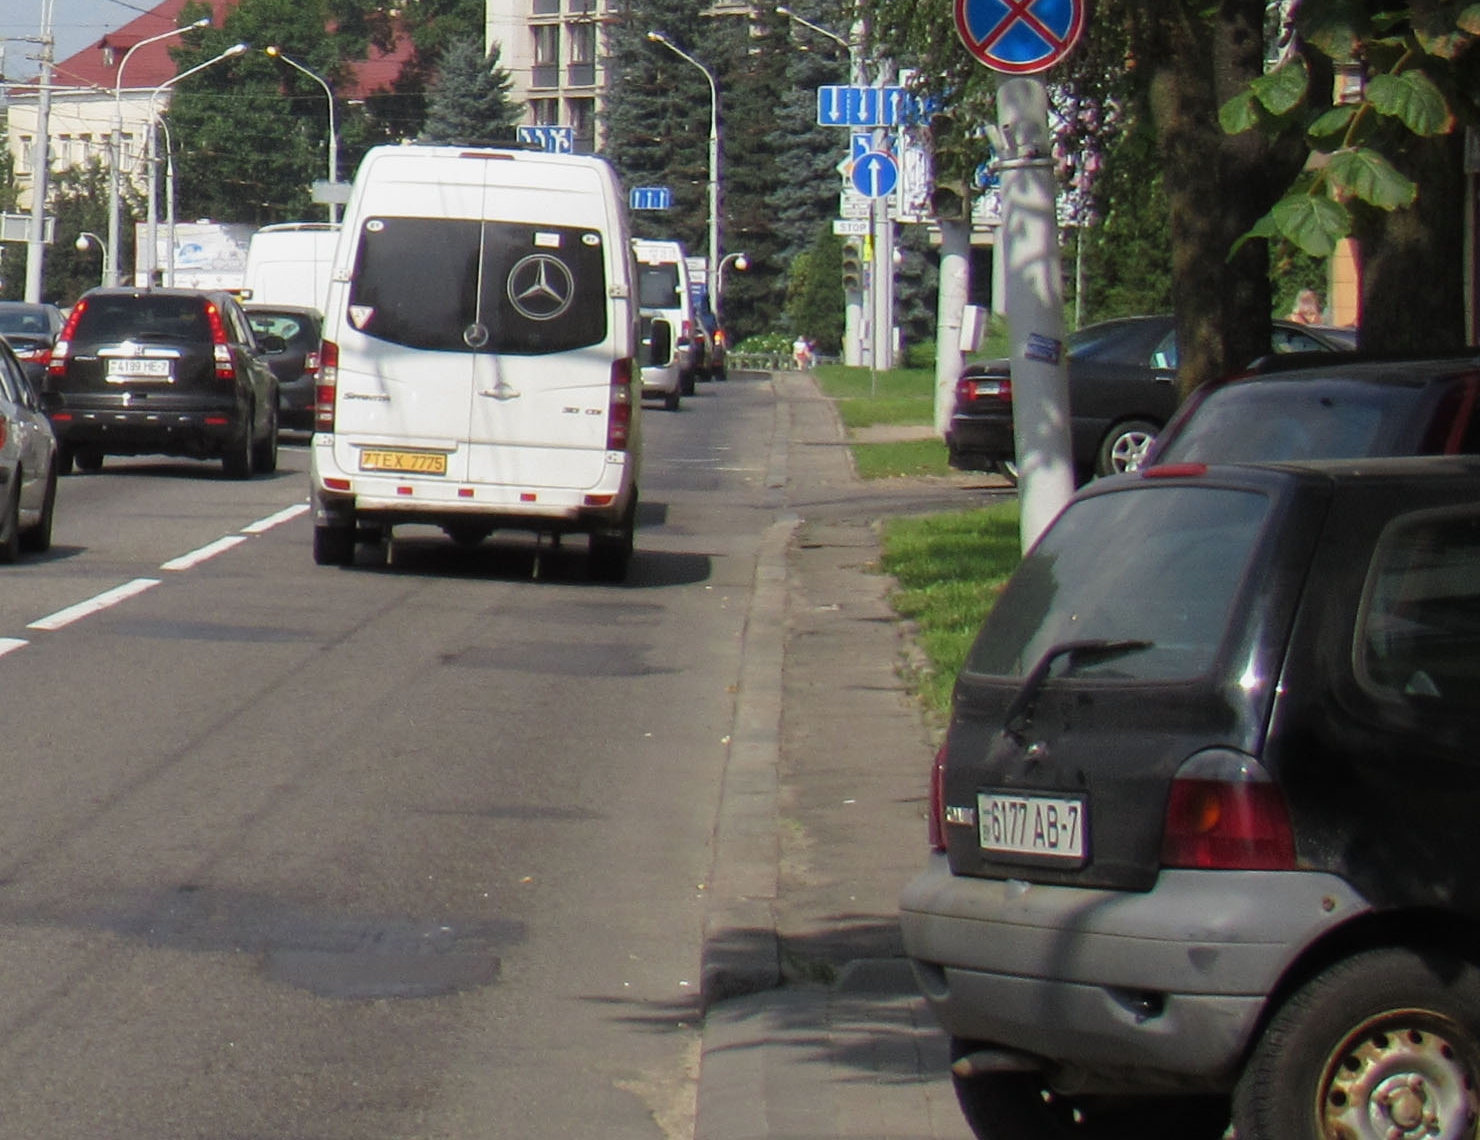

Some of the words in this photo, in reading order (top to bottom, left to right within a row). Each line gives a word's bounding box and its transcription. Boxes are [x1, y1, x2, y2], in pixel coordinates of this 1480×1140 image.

[840, 222, 867, 232] STOP
[991, 800, 1028, 845] 6177
[1033, 803, 1078, 850] AB-7
